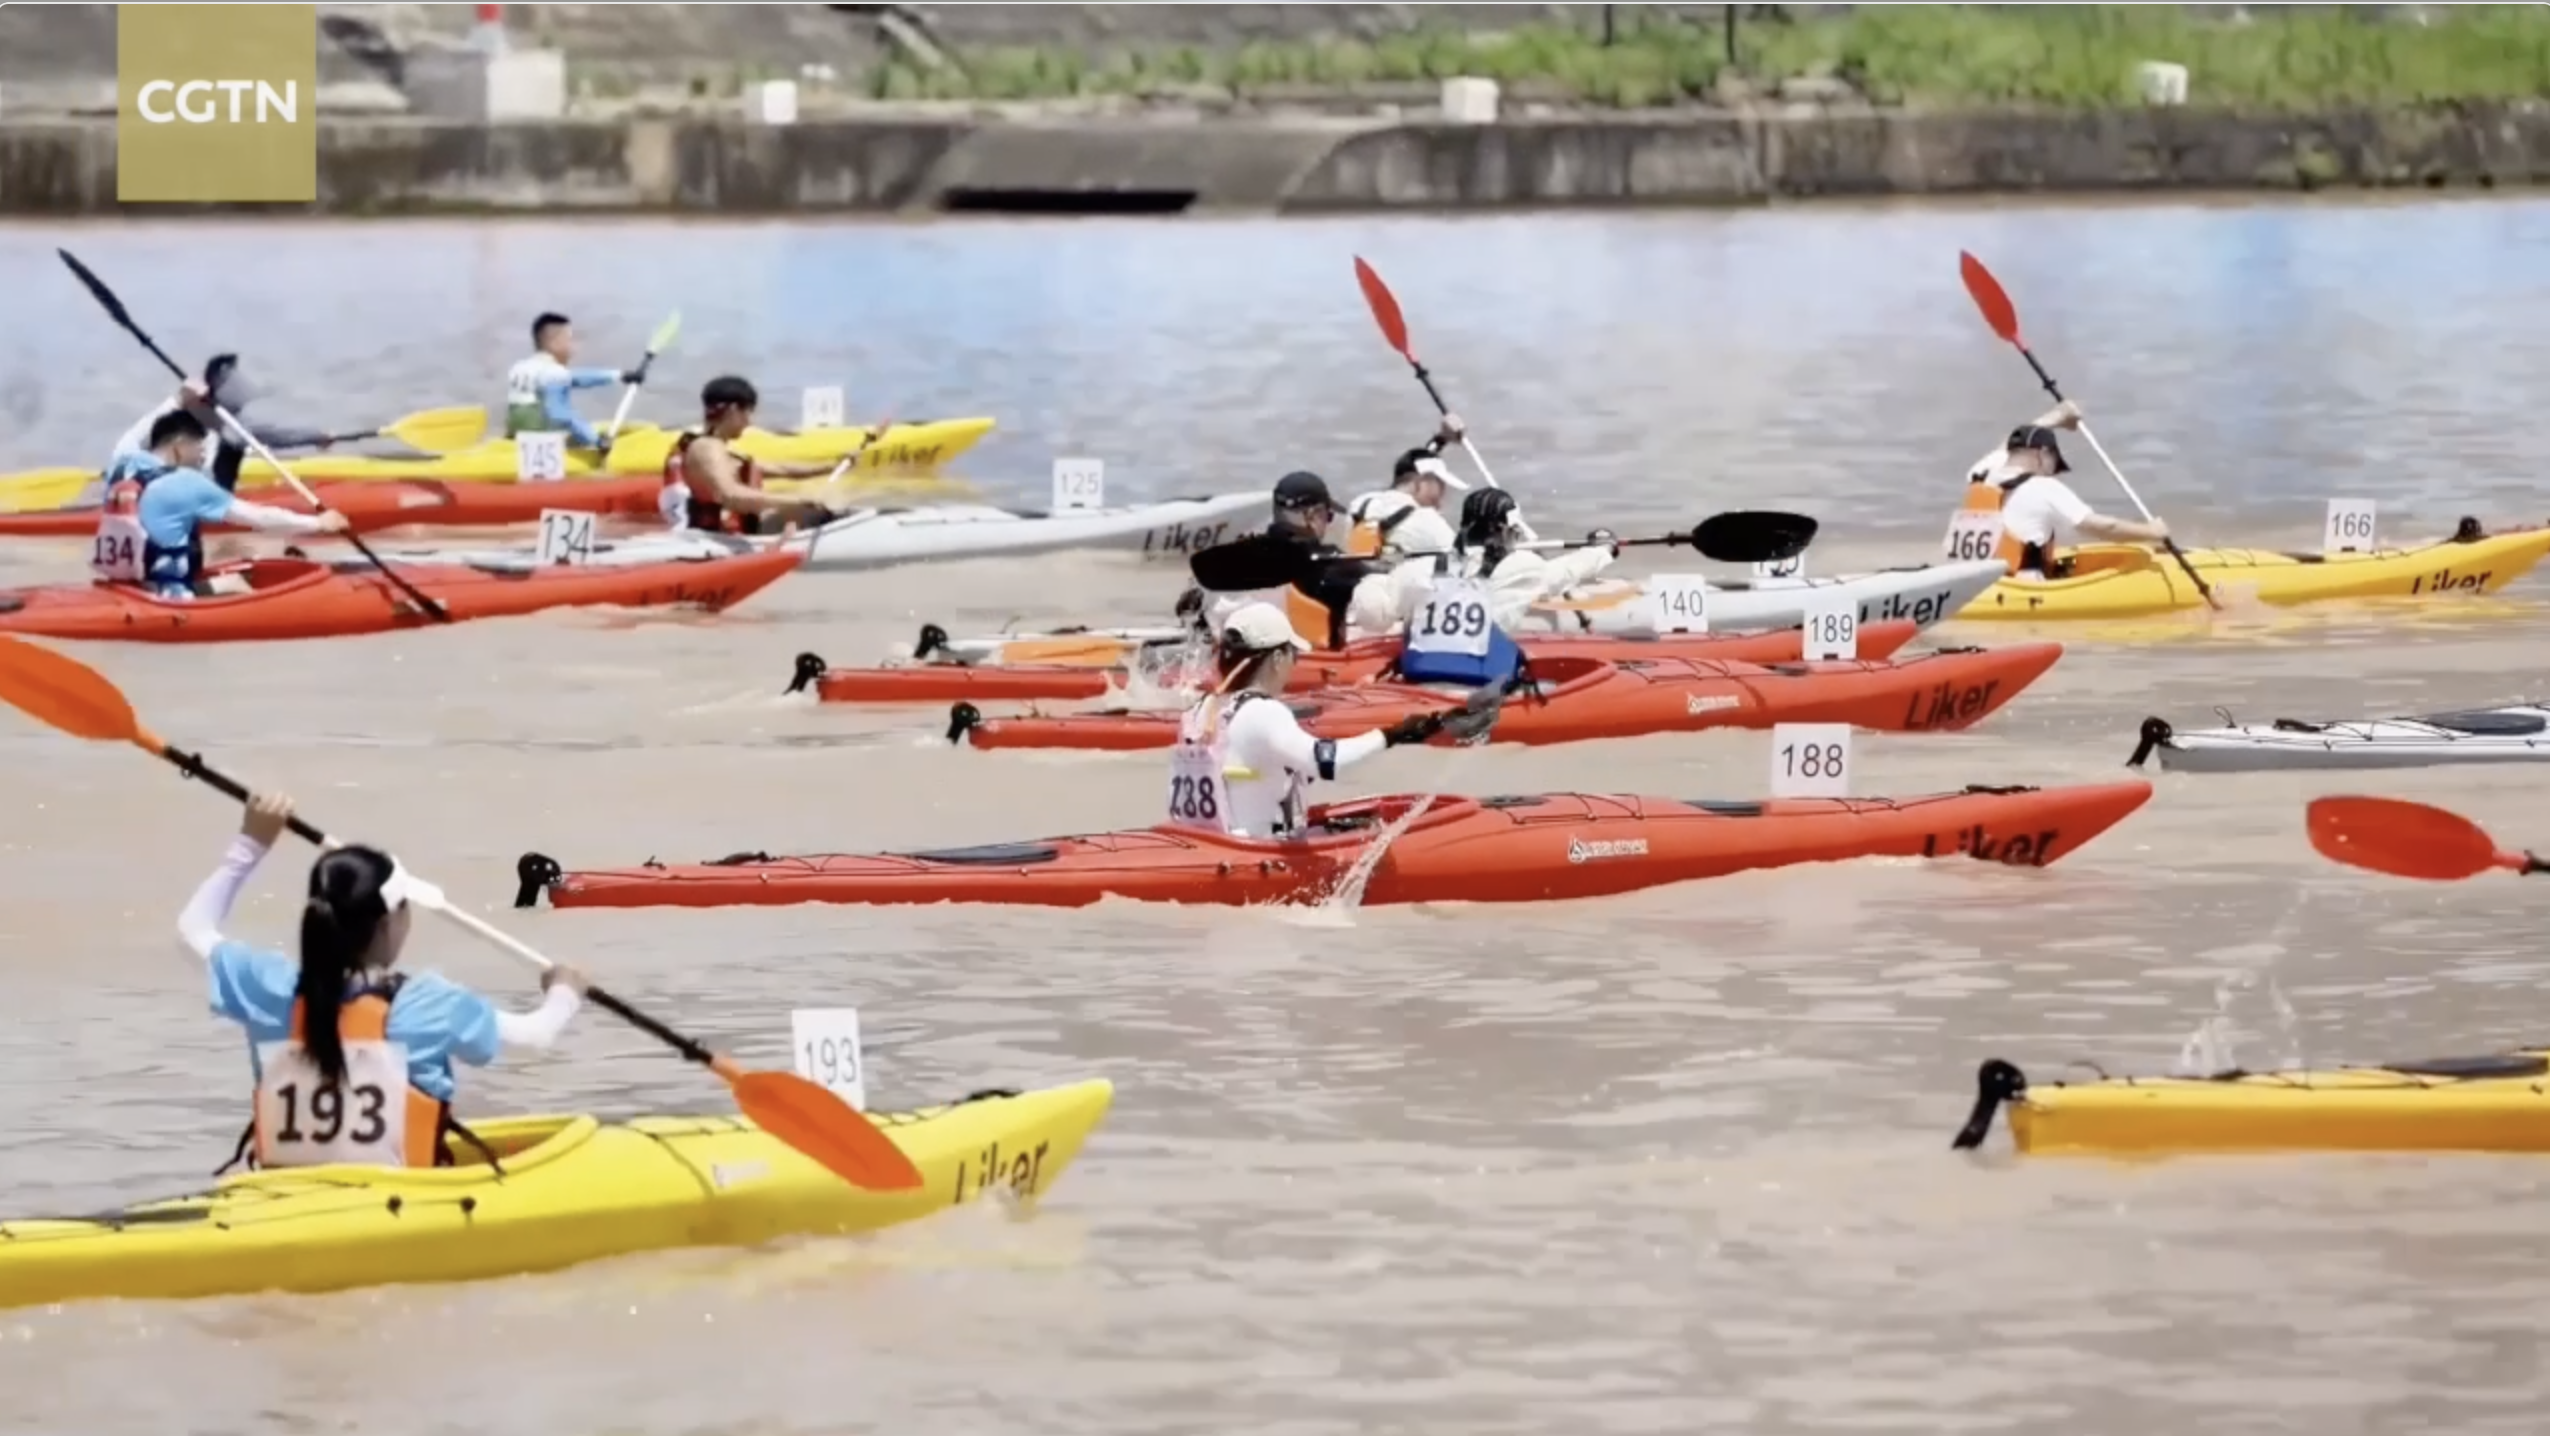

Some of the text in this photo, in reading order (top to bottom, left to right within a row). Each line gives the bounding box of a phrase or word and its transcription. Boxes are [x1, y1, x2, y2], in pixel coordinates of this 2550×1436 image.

[521, 441, 558, 474] 145
[1061, 472, 1099, 496] 125
[543, 514, 592, 566] 134
[2332, 513, 2372, 538] 166
[93, 535, 135, 566] 134
[1947, 529, 1993, 560] 166
[1421, 601, 1486, 637] 189
[1659, 590, 1704, 618] 140
[1810, 613, 1853, 644] 189
[1903, 679, 1999, 730] Liker
[1781, 743, 1844, 778] 188
[803, 1037, 858, 1085] 193
[276, 1083, 387, 1143] 193
